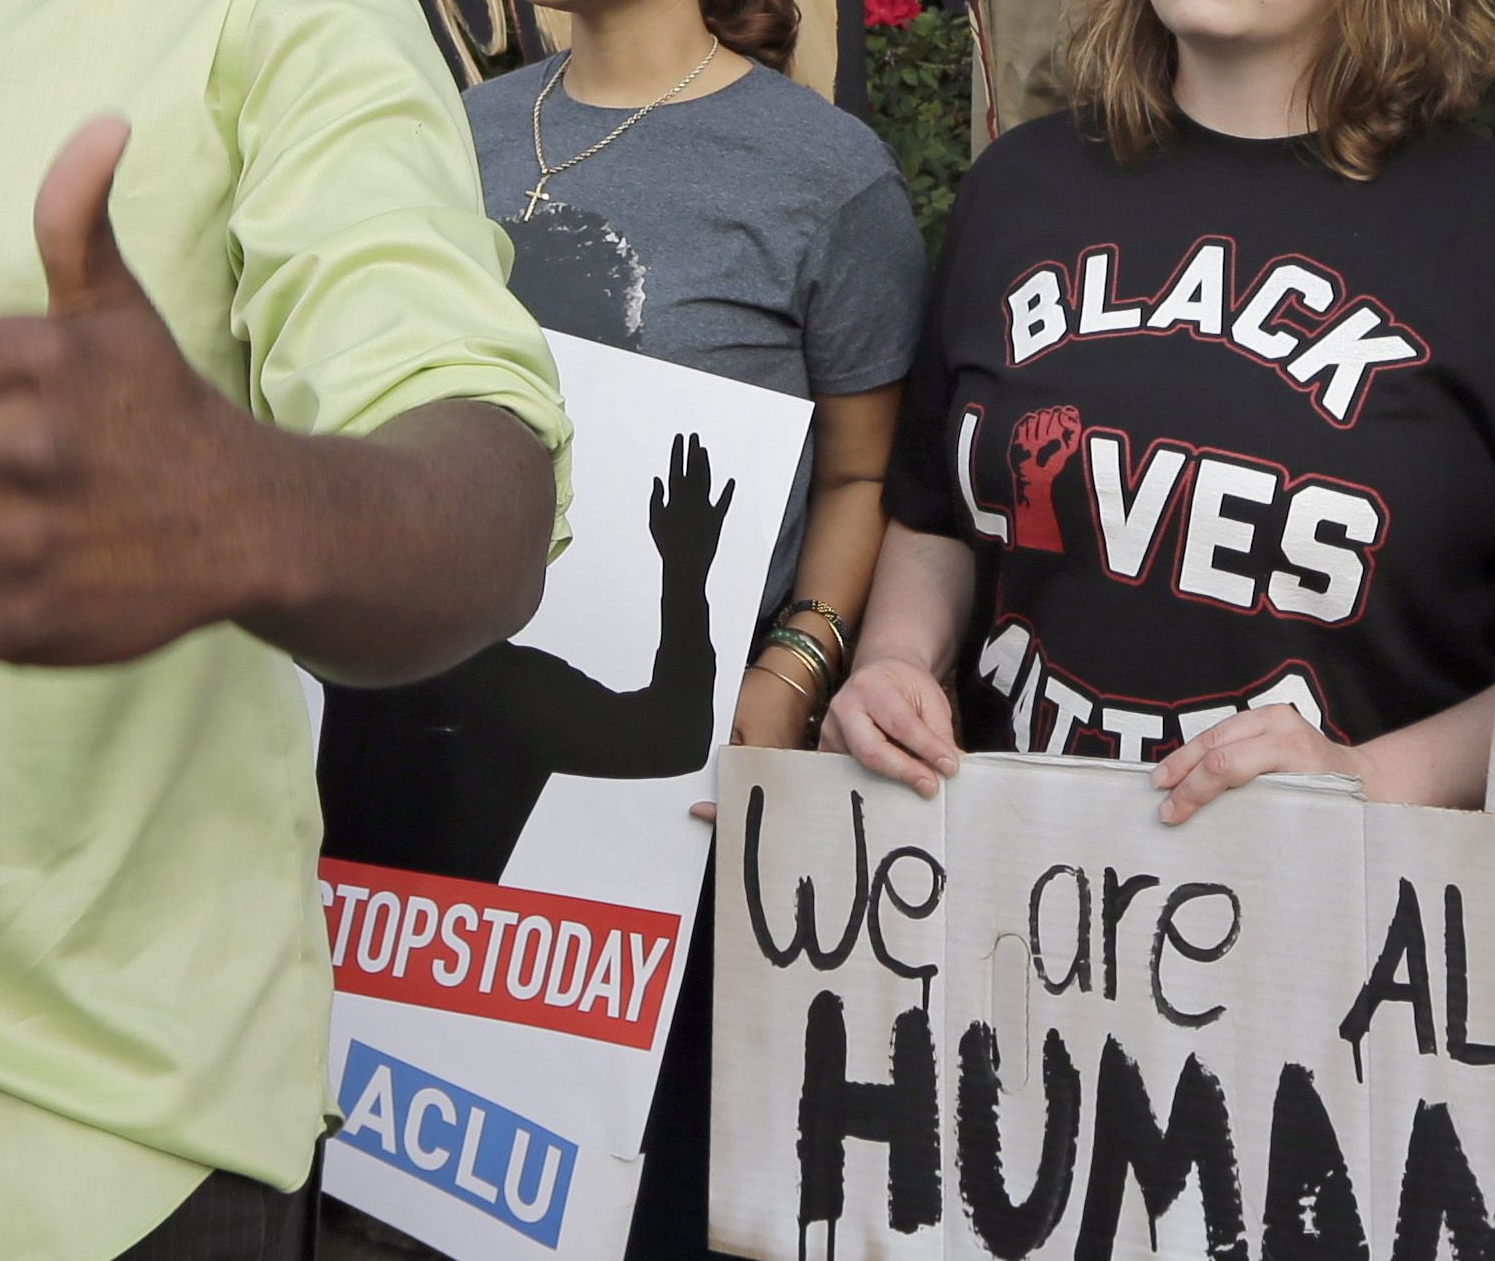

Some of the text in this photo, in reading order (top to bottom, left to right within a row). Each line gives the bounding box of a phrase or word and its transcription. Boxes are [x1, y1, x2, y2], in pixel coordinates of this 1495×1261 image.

[1005, 242, 1419, 422] BLACK
[742, 784, 946, 983] We
[1028, 861, 1242, 1030] are
[343, 1064, 563, 1224] ACLU
